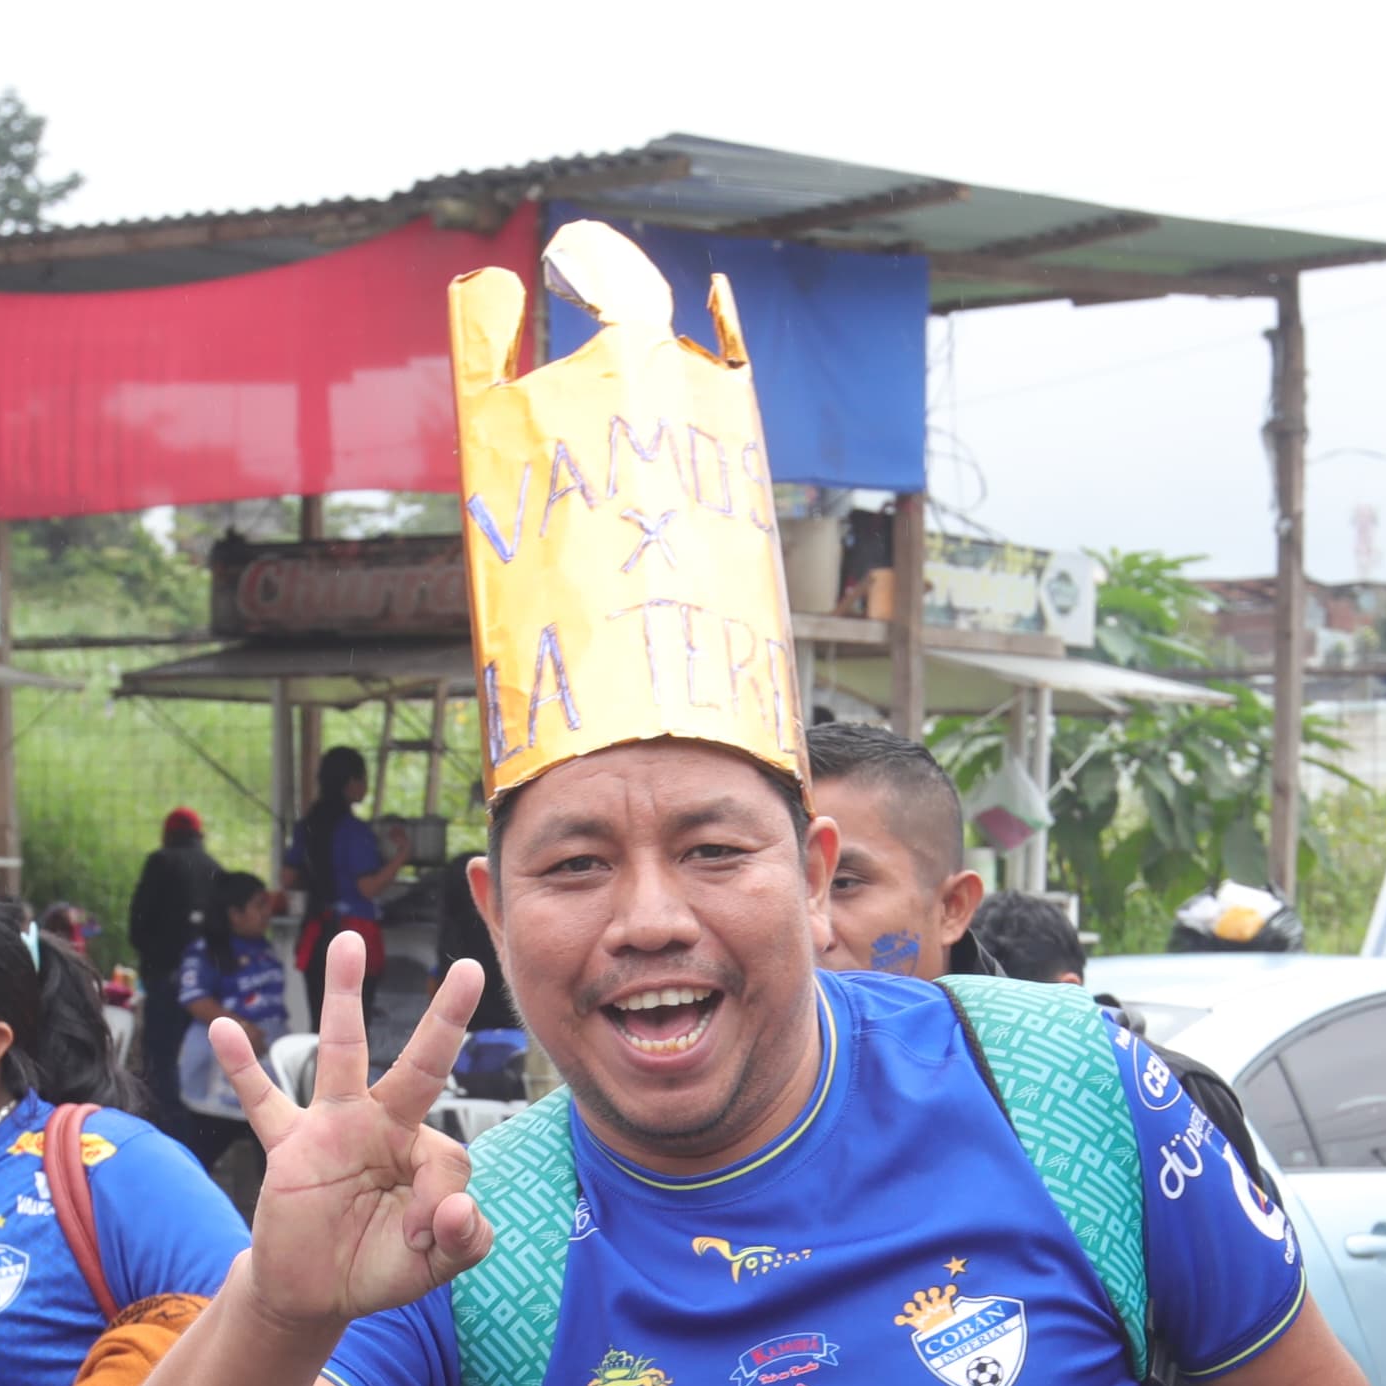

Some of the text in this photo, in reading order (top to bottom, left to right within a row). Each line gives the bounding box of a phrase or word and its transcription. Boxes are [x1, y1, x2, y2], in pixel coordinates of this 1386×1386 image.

[620, 508, 678, 574] X
[484, 623, 581, 767] LA
[924, 1304, 1006, 1356] COBÁN
[940, 1324, 1011, 1363] IMPERIAL
